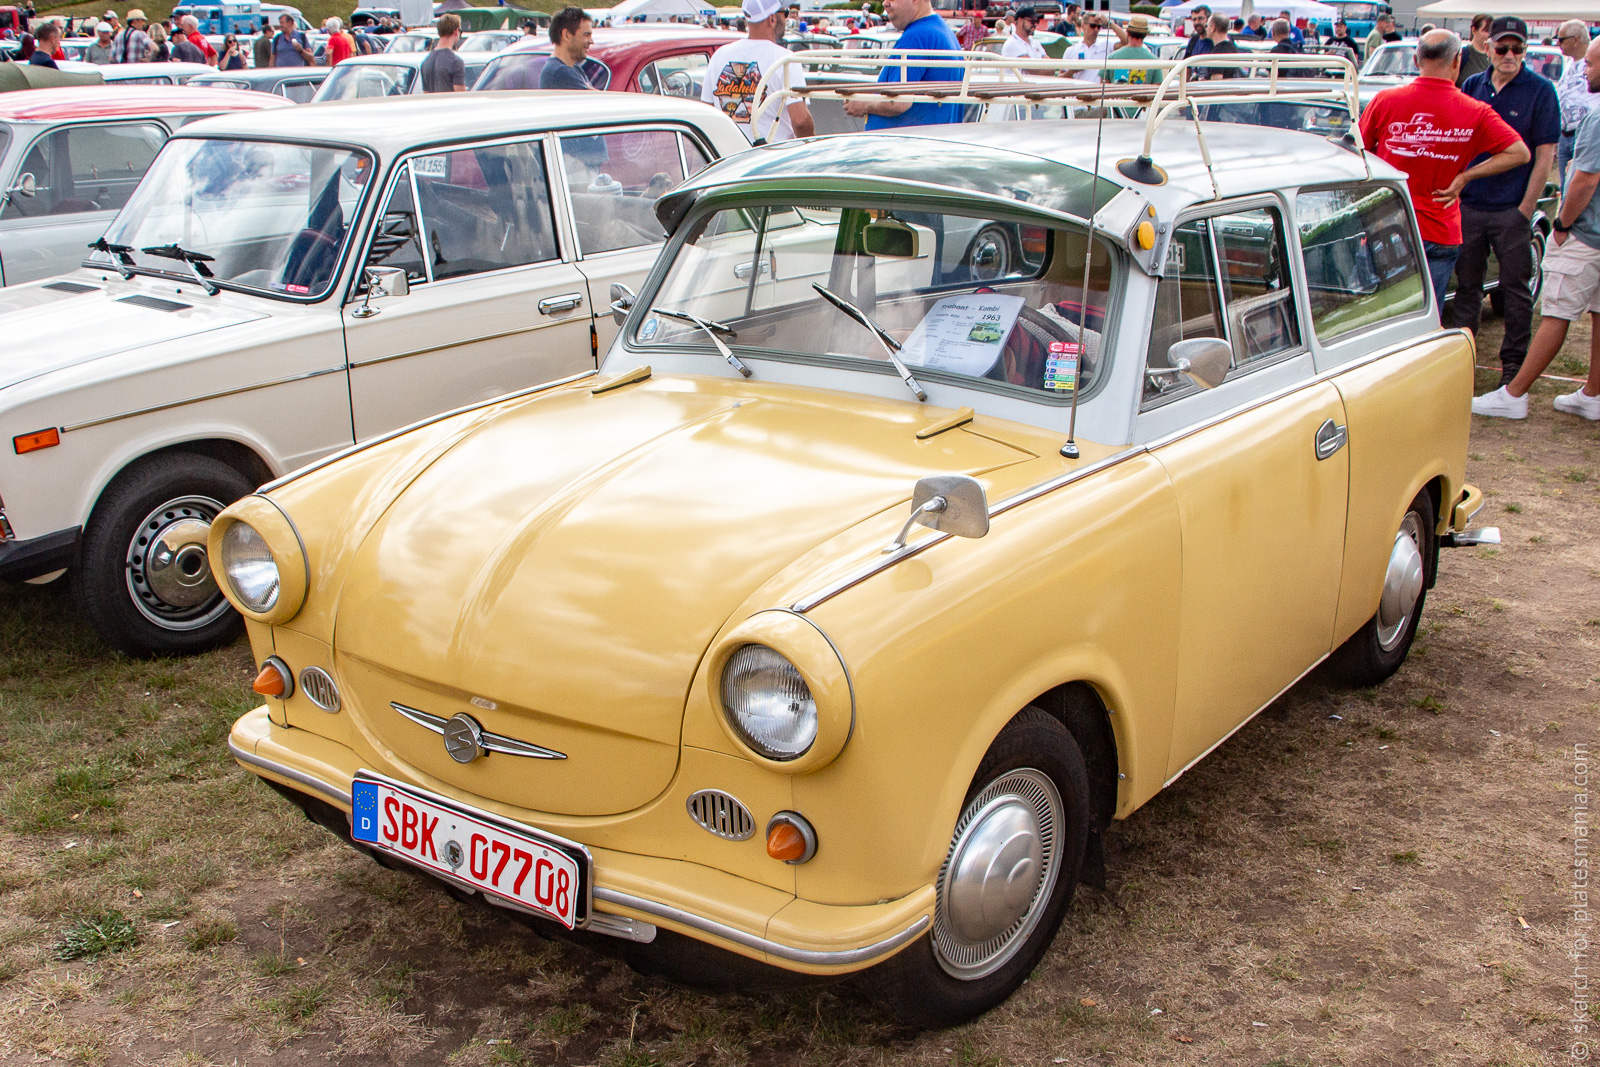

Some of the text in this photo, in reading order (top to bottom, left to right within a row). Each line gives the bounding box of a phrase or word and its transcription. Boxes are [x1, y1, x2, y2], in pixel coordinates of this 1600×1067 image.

[1414, 127, 1442, 136] Legends
[1416, 147, 1459, 162] Germany
[941, 303, 969, 311] Trabant
[361, 817, 371, 830] D
[383, 796, 570, 918] SBK 07708
